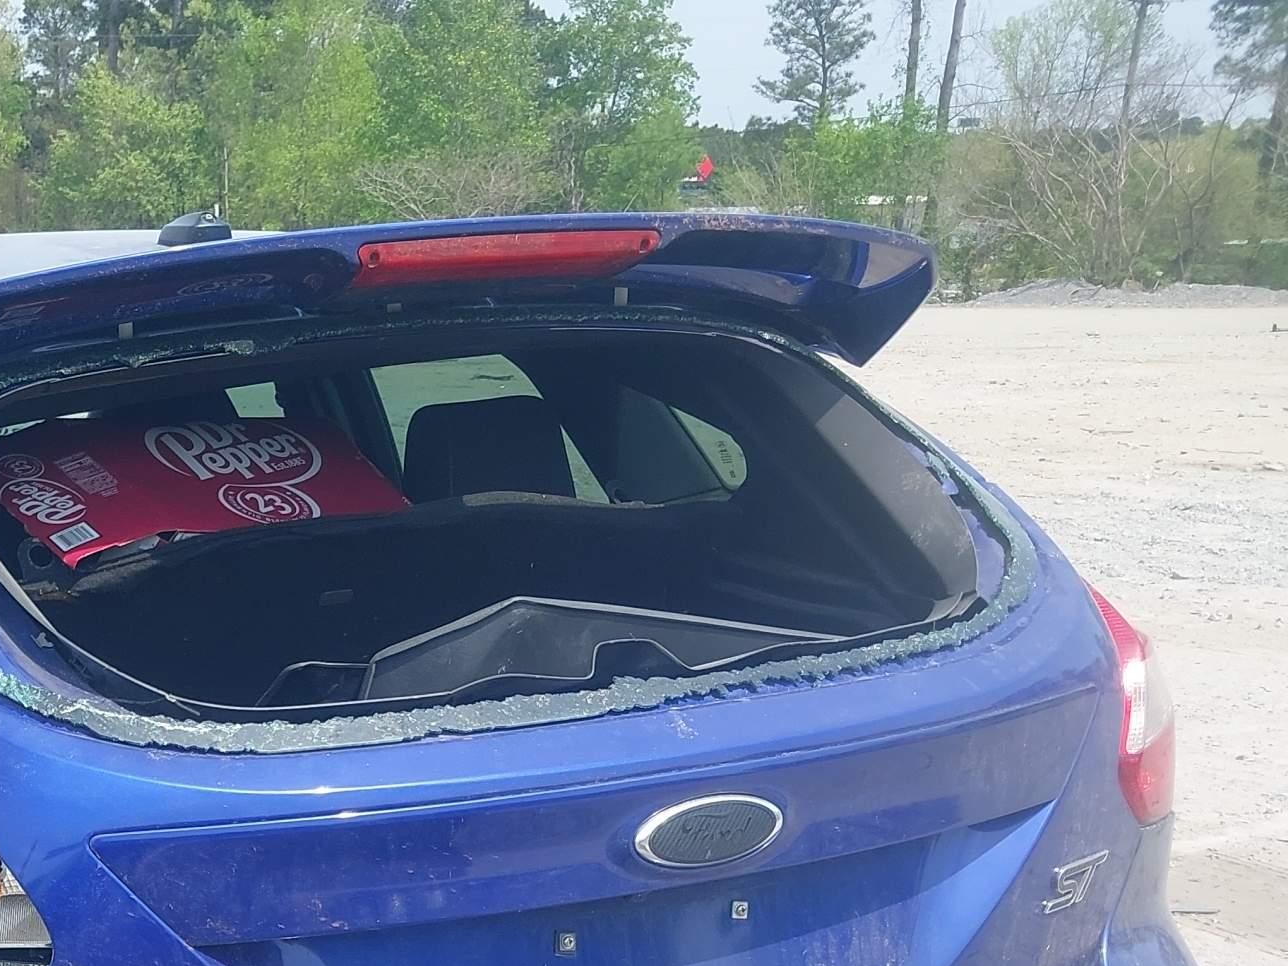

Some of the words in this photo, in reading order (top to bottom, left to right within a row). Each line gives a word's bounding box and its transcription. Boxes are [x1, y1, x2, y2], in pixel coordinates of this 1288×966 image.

[185, 420, 249, 449] Dr
[144, 425, 300, 480] Pepper
[9, 483, 87, 524] Pepper
[11, 496, 43, 516] Dr
[245, 492, 292, 514] 23
[1042, 849, 1110, 914] ST
